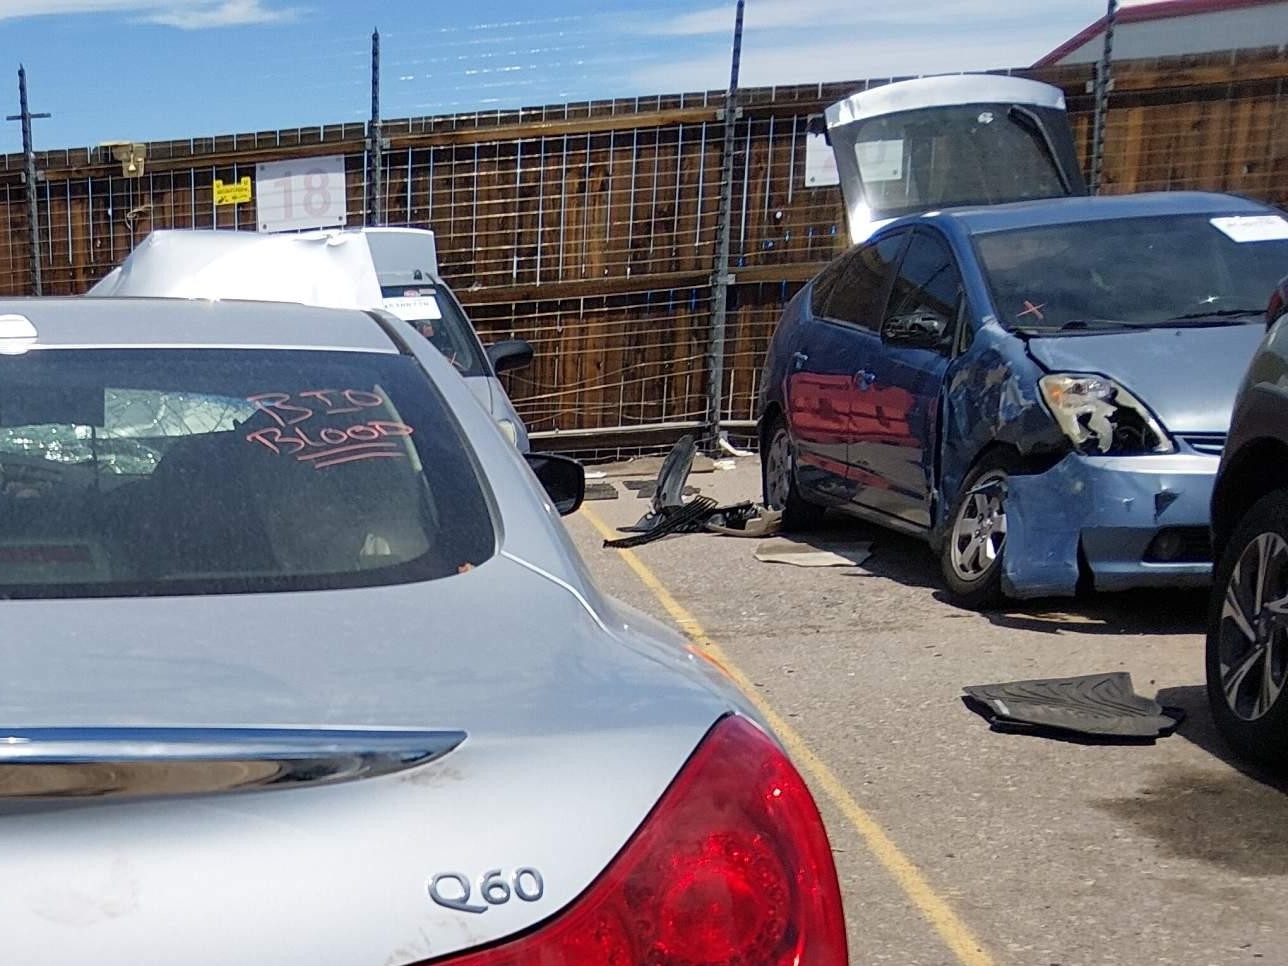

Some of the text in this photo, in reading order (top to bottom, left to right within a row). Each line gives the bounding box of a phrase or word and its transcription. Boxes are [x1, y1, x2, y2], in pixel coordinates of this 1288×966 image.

[273, 167, 332, 220] 18
[246, 420, 414, 455] BLOOD
[427, 866, 544, 914] Q60
